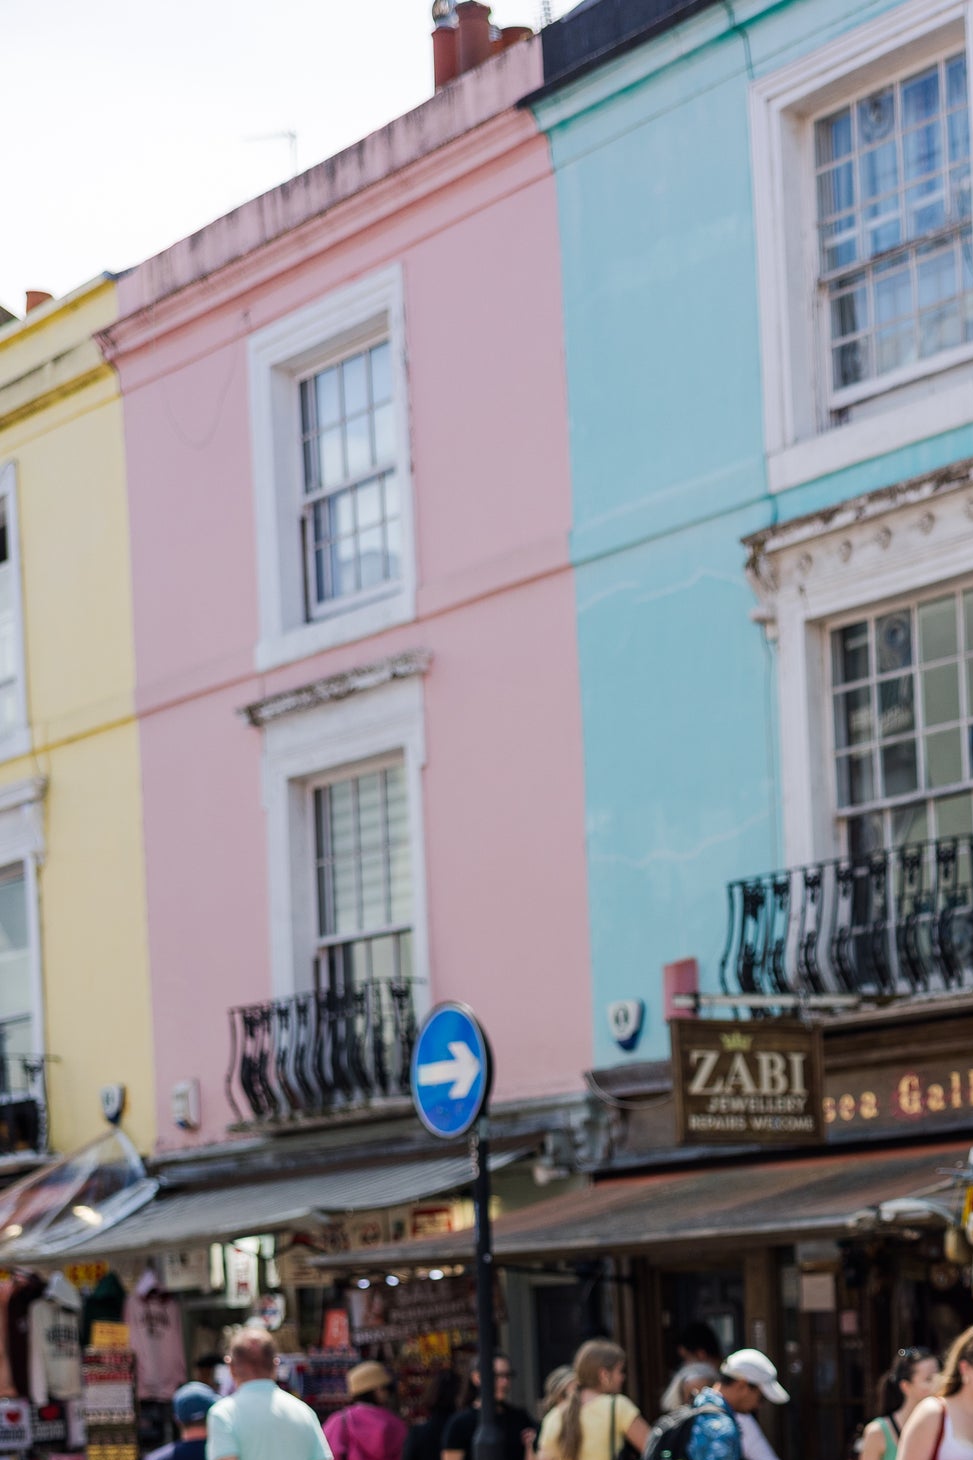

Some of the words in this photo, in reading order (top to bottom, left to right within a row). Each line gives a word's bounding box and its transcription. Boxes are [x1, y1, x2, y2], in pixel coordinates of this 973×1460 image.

[688, 1049, 809, 1096] ZABI
[708, 1095, 808, 1114] JEWELLERY
[750, 1114, 815, 1133] WELCOME
